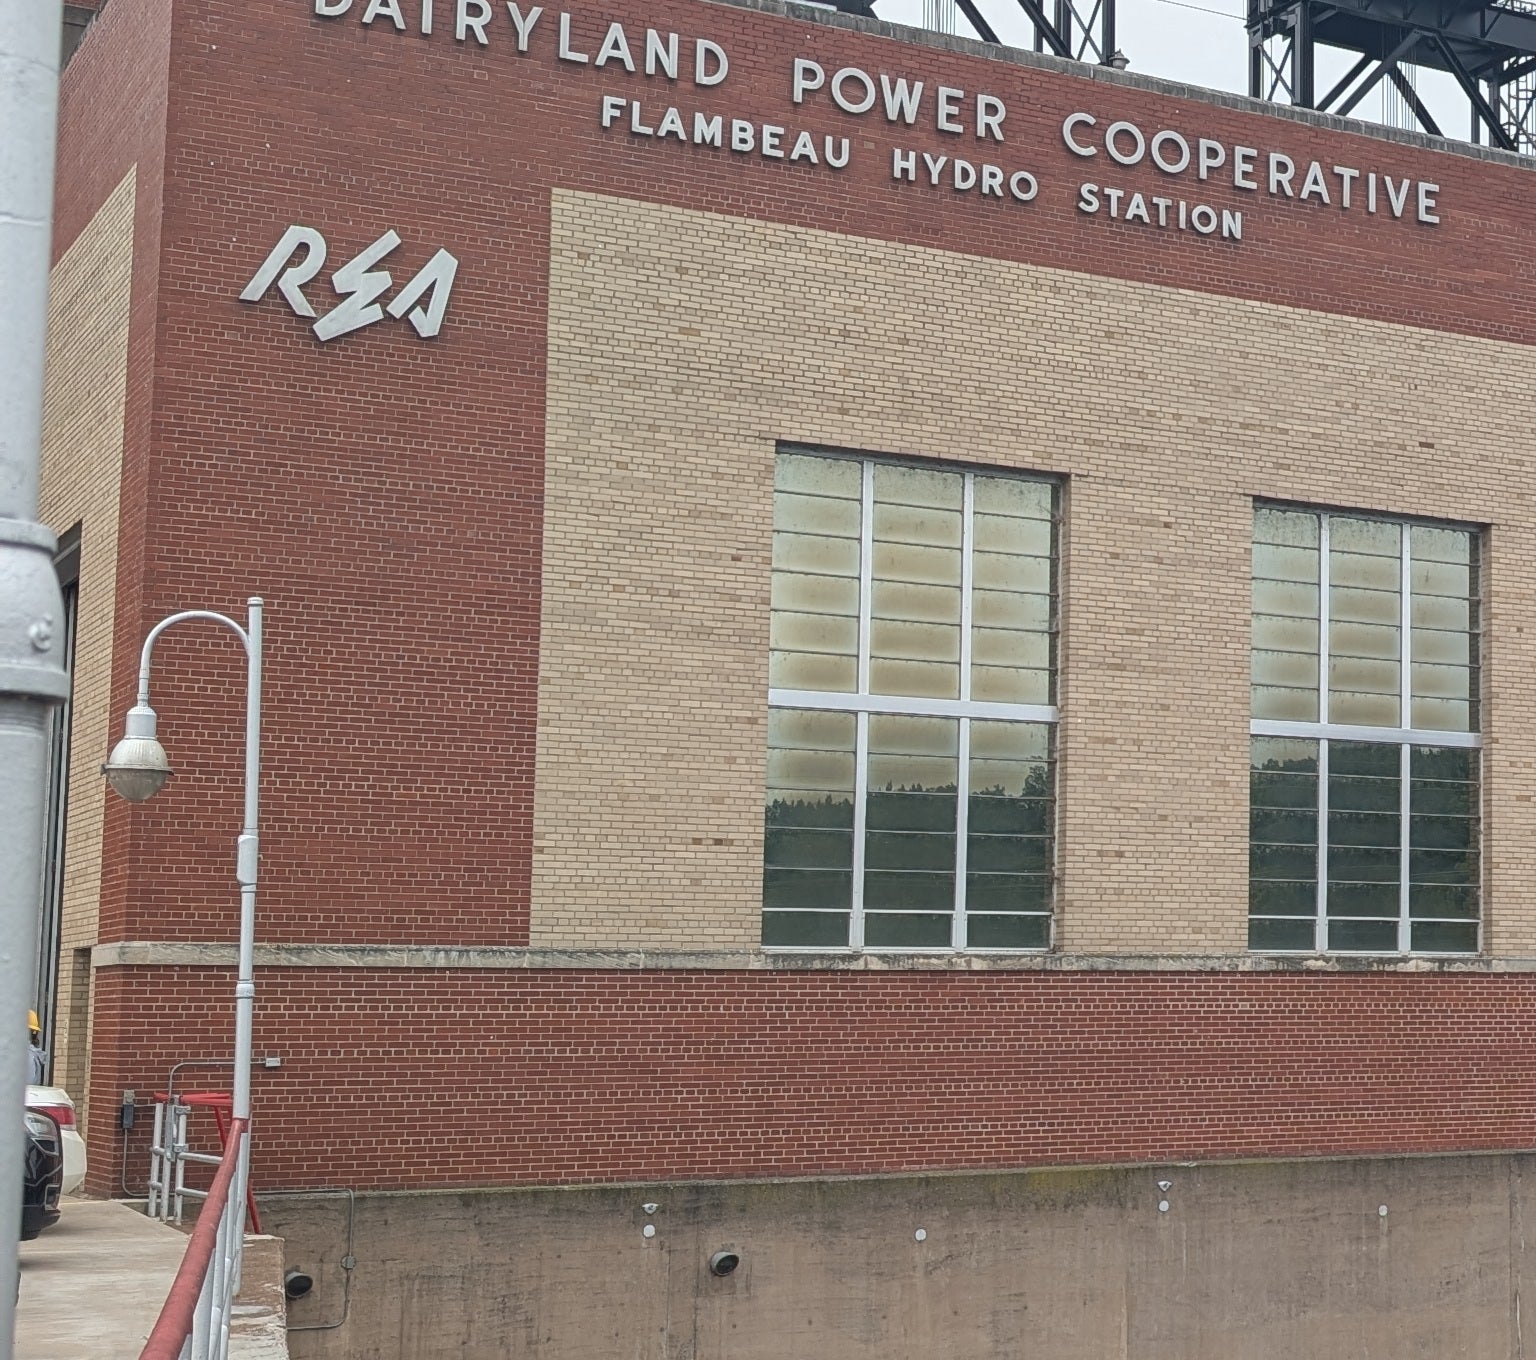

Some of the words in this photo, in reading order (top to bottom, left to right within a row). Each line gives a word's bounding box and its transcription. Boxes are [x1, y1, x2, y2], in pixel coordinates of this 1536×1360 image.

[601, 95, 851, 170] FLAMBEAU
[892, 146, 1040, 203] HYDRO
[1077, 181, 1245, 242] STATION
[791, 57, 1008, 143] POWER
[1061, 110, 1442, 226] COOPERATIVE
